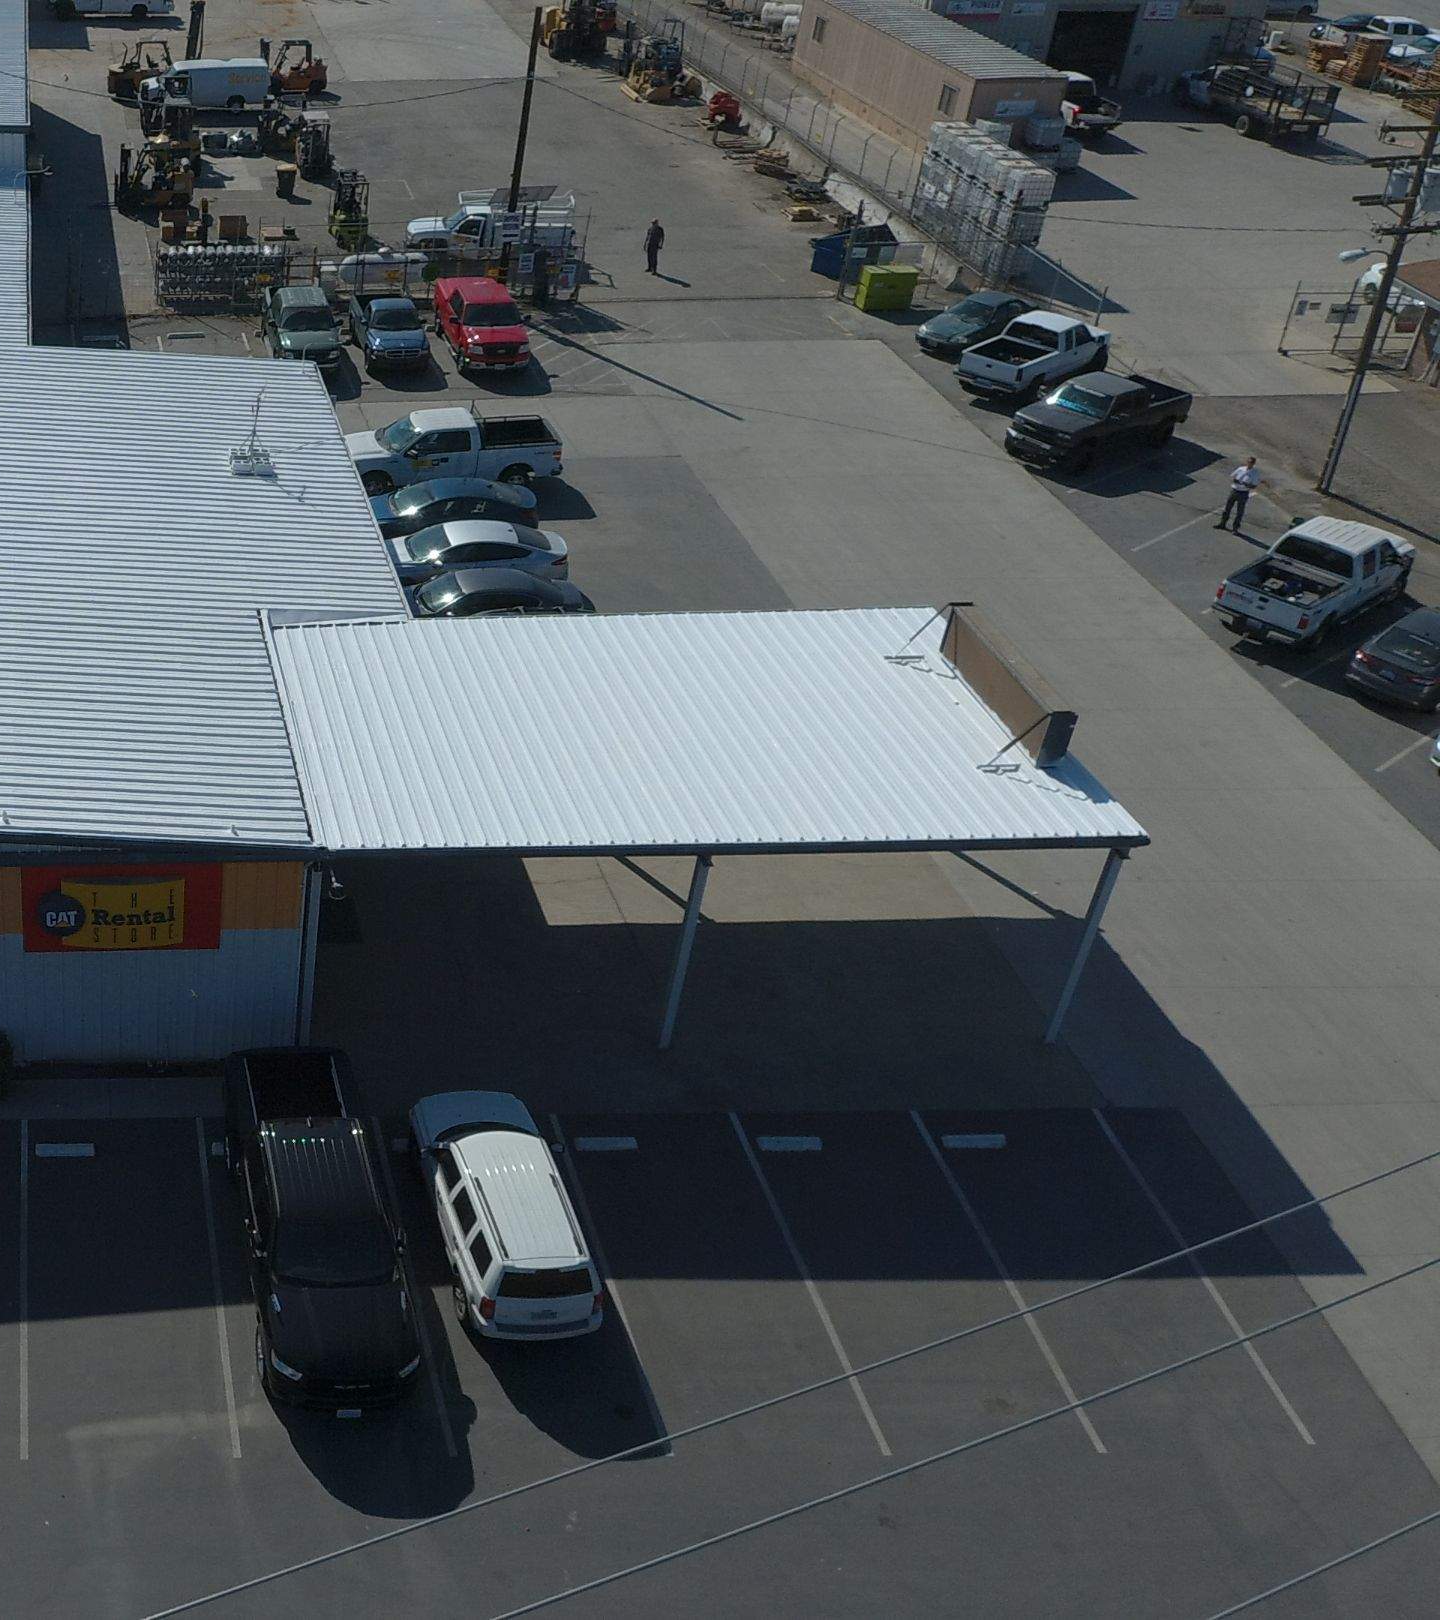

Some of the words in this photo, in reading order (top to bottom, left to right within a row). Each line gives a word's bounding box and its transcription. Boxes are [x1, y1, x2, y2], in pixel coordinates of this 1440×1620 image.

[91, 888, 175, 908] THE
[46, 911, 78, 928] CAT
[91, 905, 176, 926] Rental
[93, 923, 175, 943] STORE
